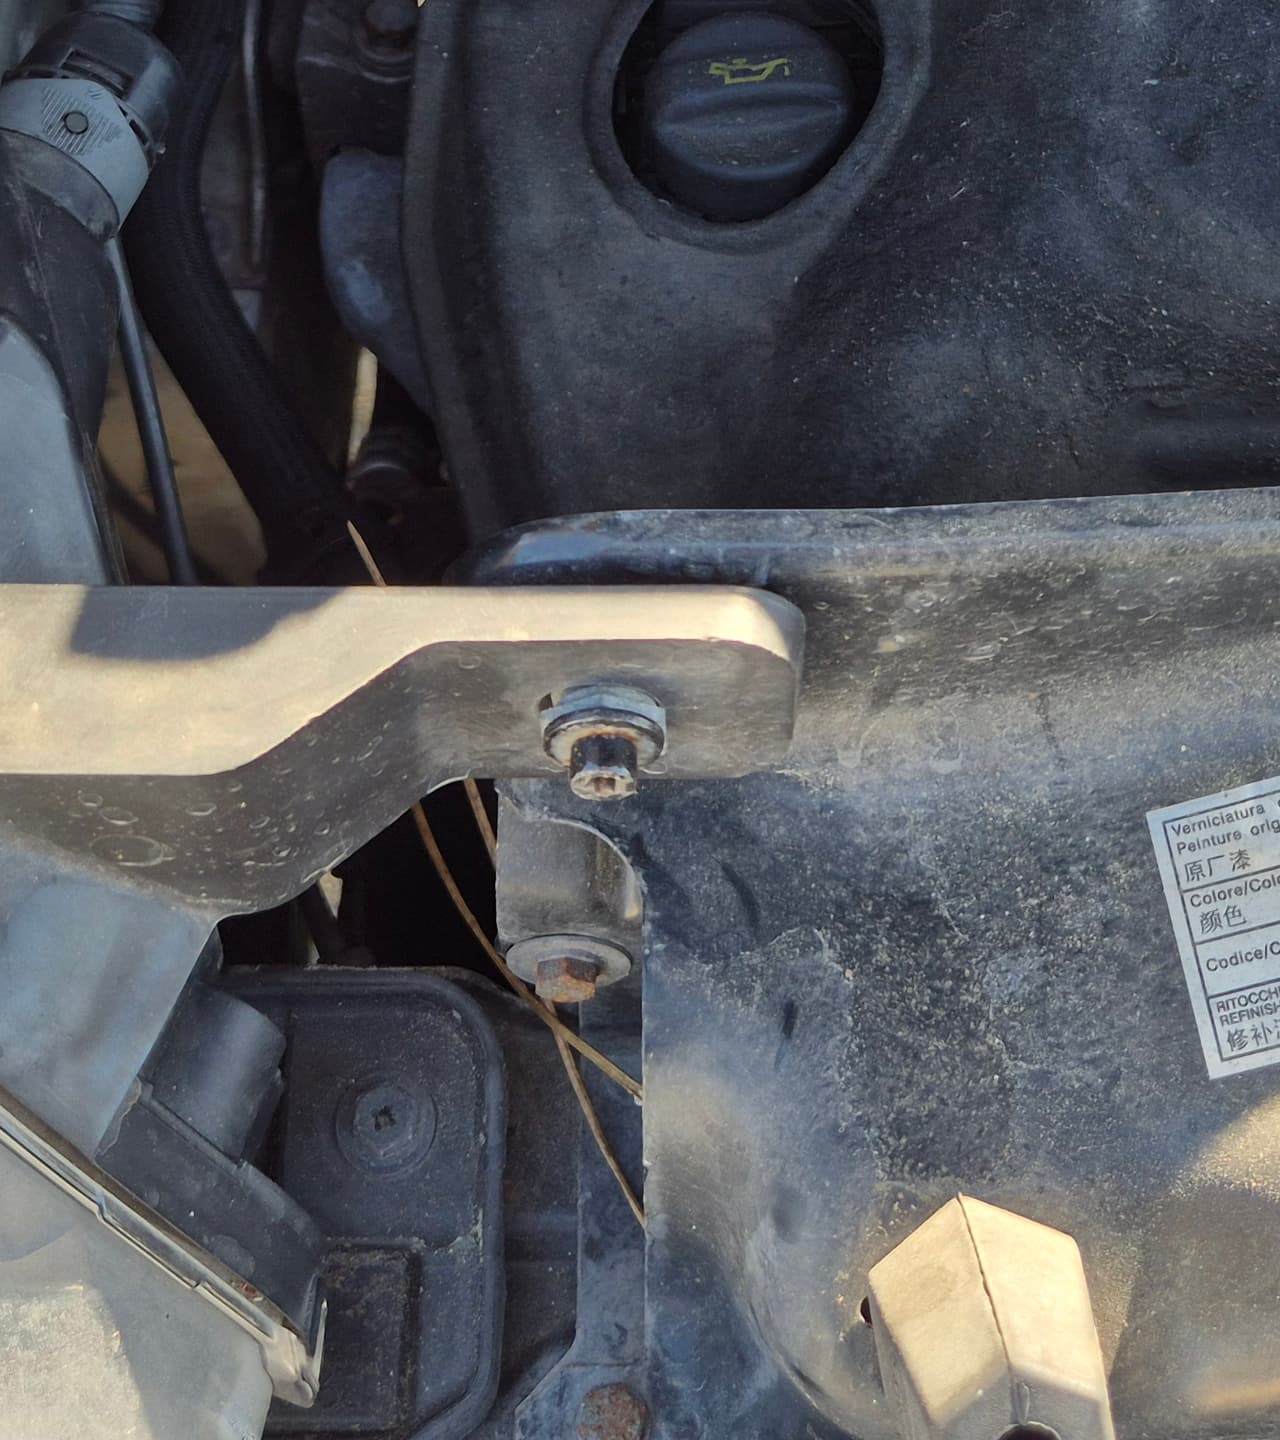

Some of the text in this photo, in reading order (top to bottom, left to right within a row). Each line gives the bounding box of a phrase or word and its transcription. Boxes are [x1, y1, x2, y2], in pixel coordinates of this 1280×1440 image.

[1171, 800, 1265, 838] Verniciatura
[1175, 826, 1242, 856] Peinture
[1182, 846, 1252, 884] 原厂漆
[1197, 901, 1247, 935] 颜色
